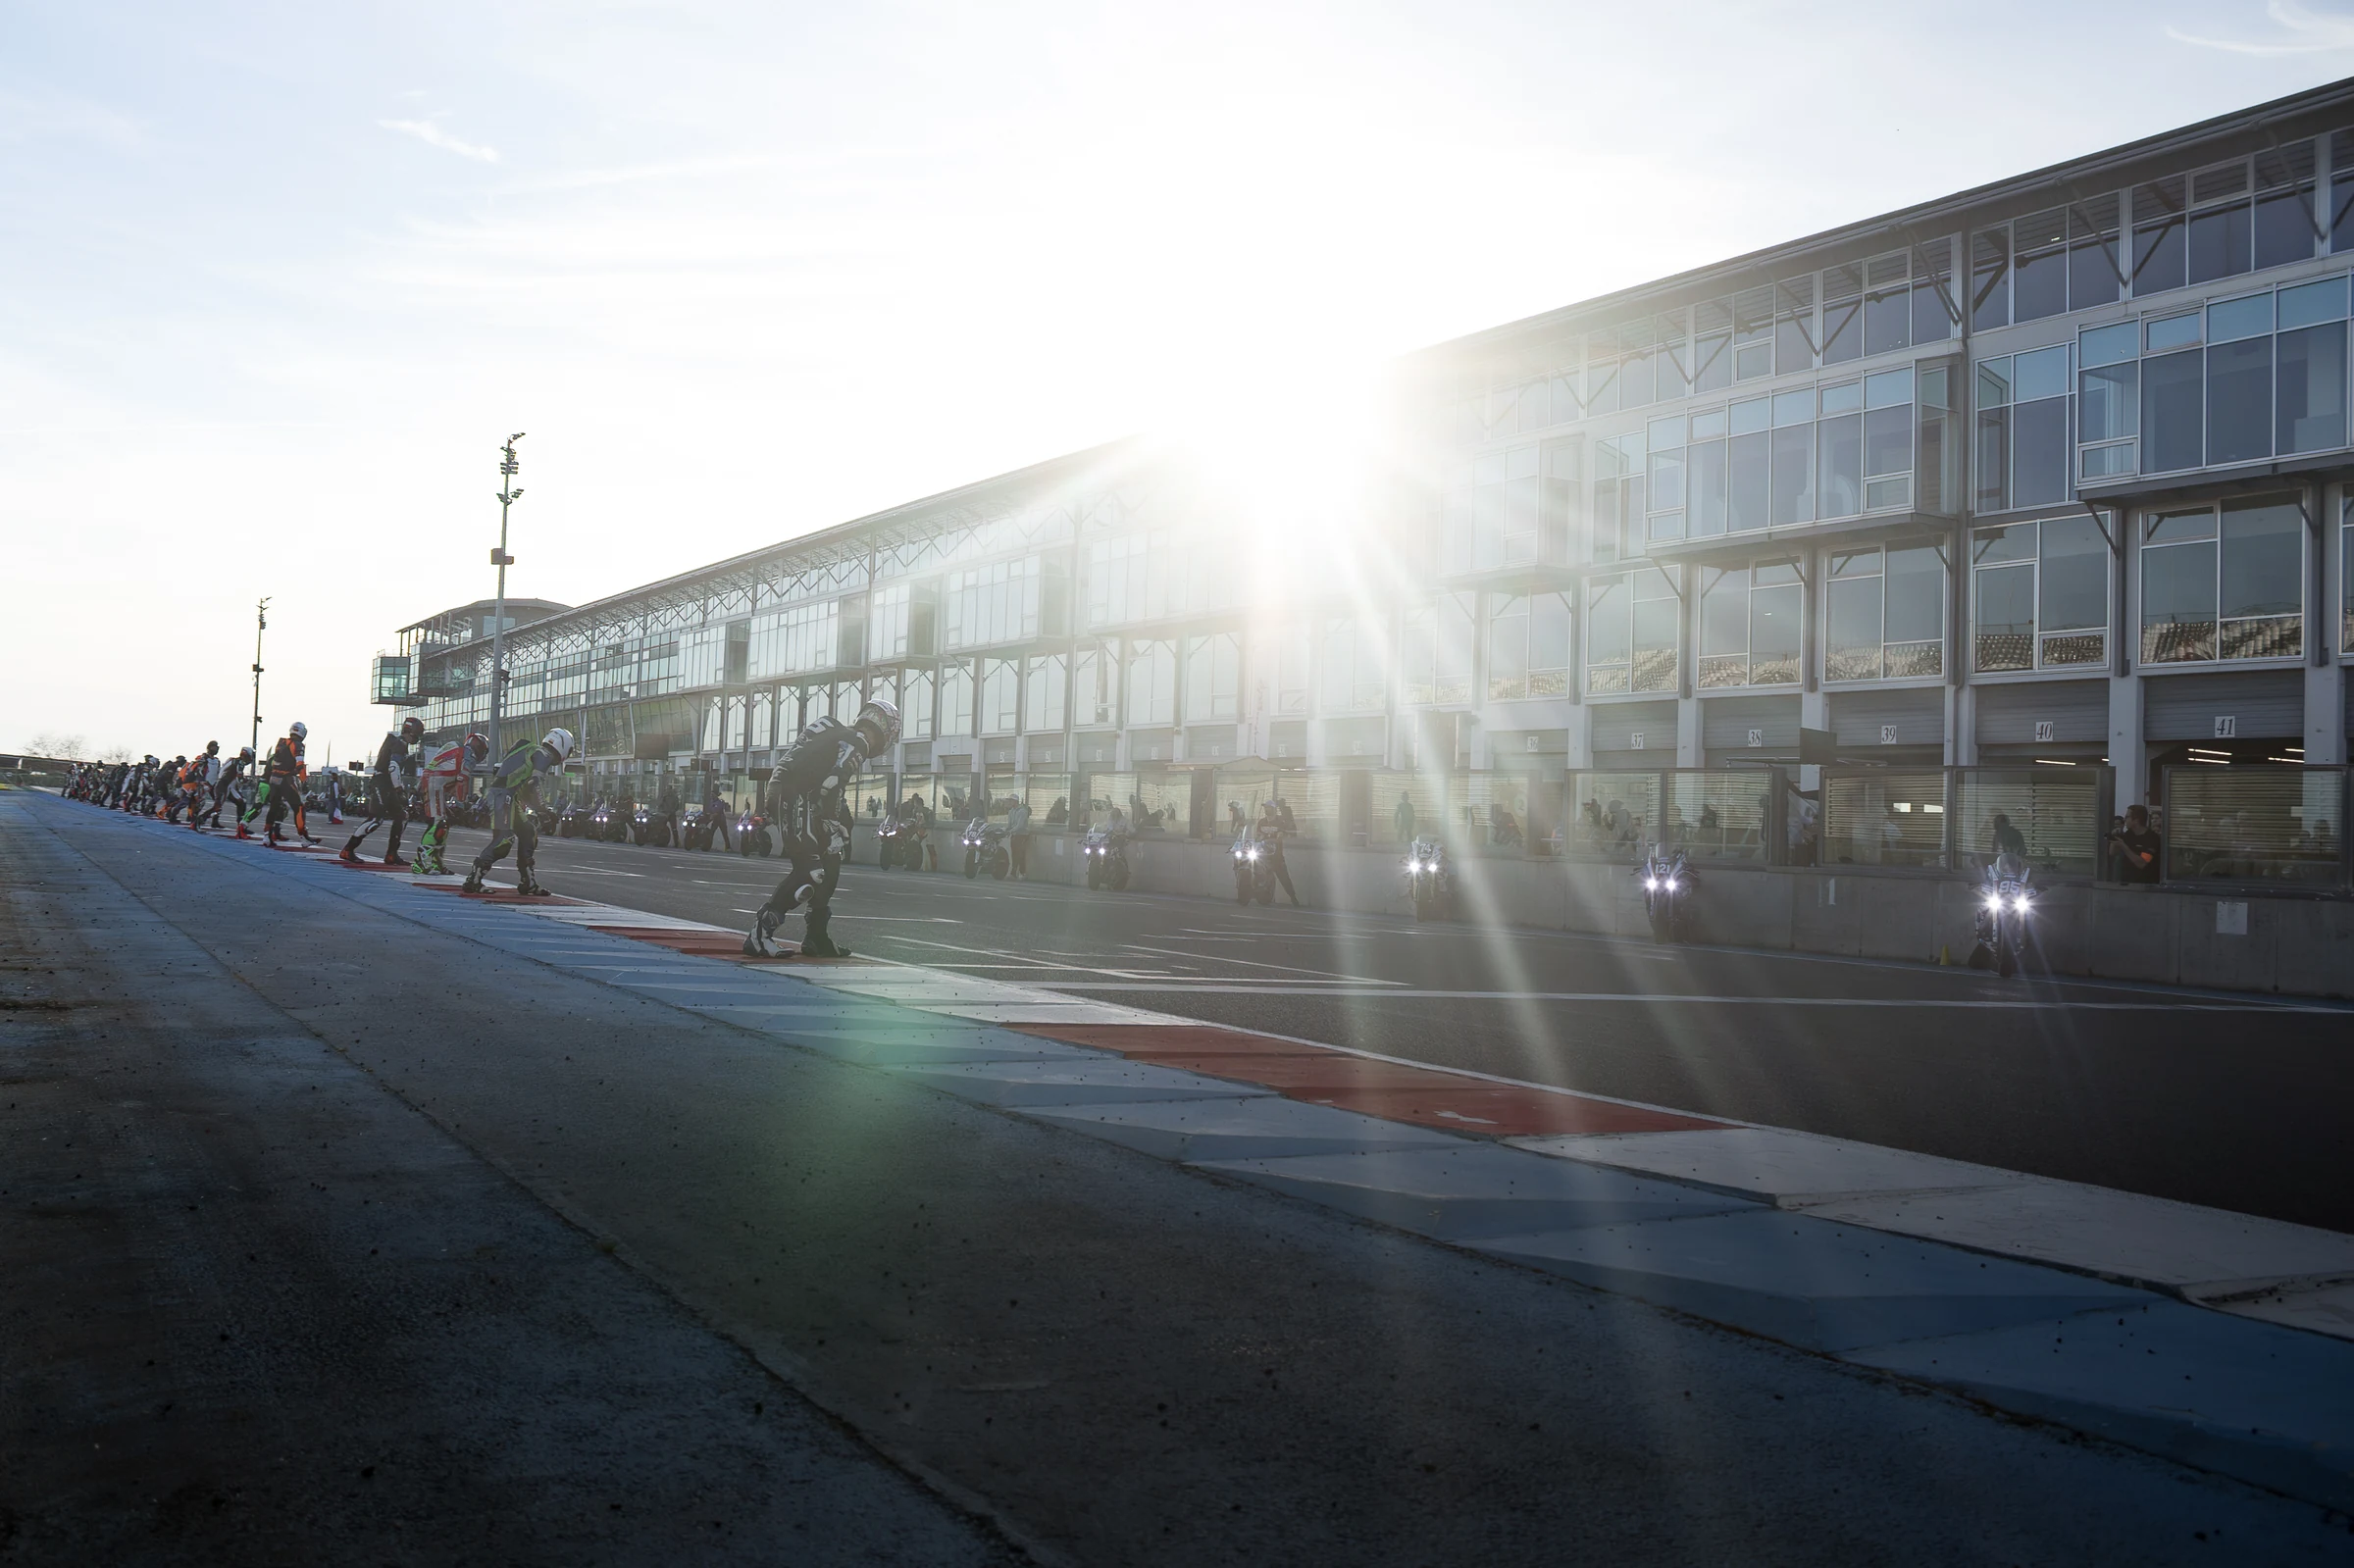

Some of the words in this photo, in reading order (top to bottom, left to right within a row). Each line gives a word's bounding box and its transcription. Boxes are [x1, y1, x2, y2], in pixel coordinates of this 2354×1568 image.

[2036, 723, 2053, 739] 40
[2217, 718, 2233, 735] 41
[1632, 734, 1644, 748] 37
[1748, 731, 1761, 745] 38
[1882, 727, 1896, 742] 39
[1419, 843, 1432, 853] 74
[1655, 863, 1670, 874] 121
[1998, 881, 2021, 894] 95
